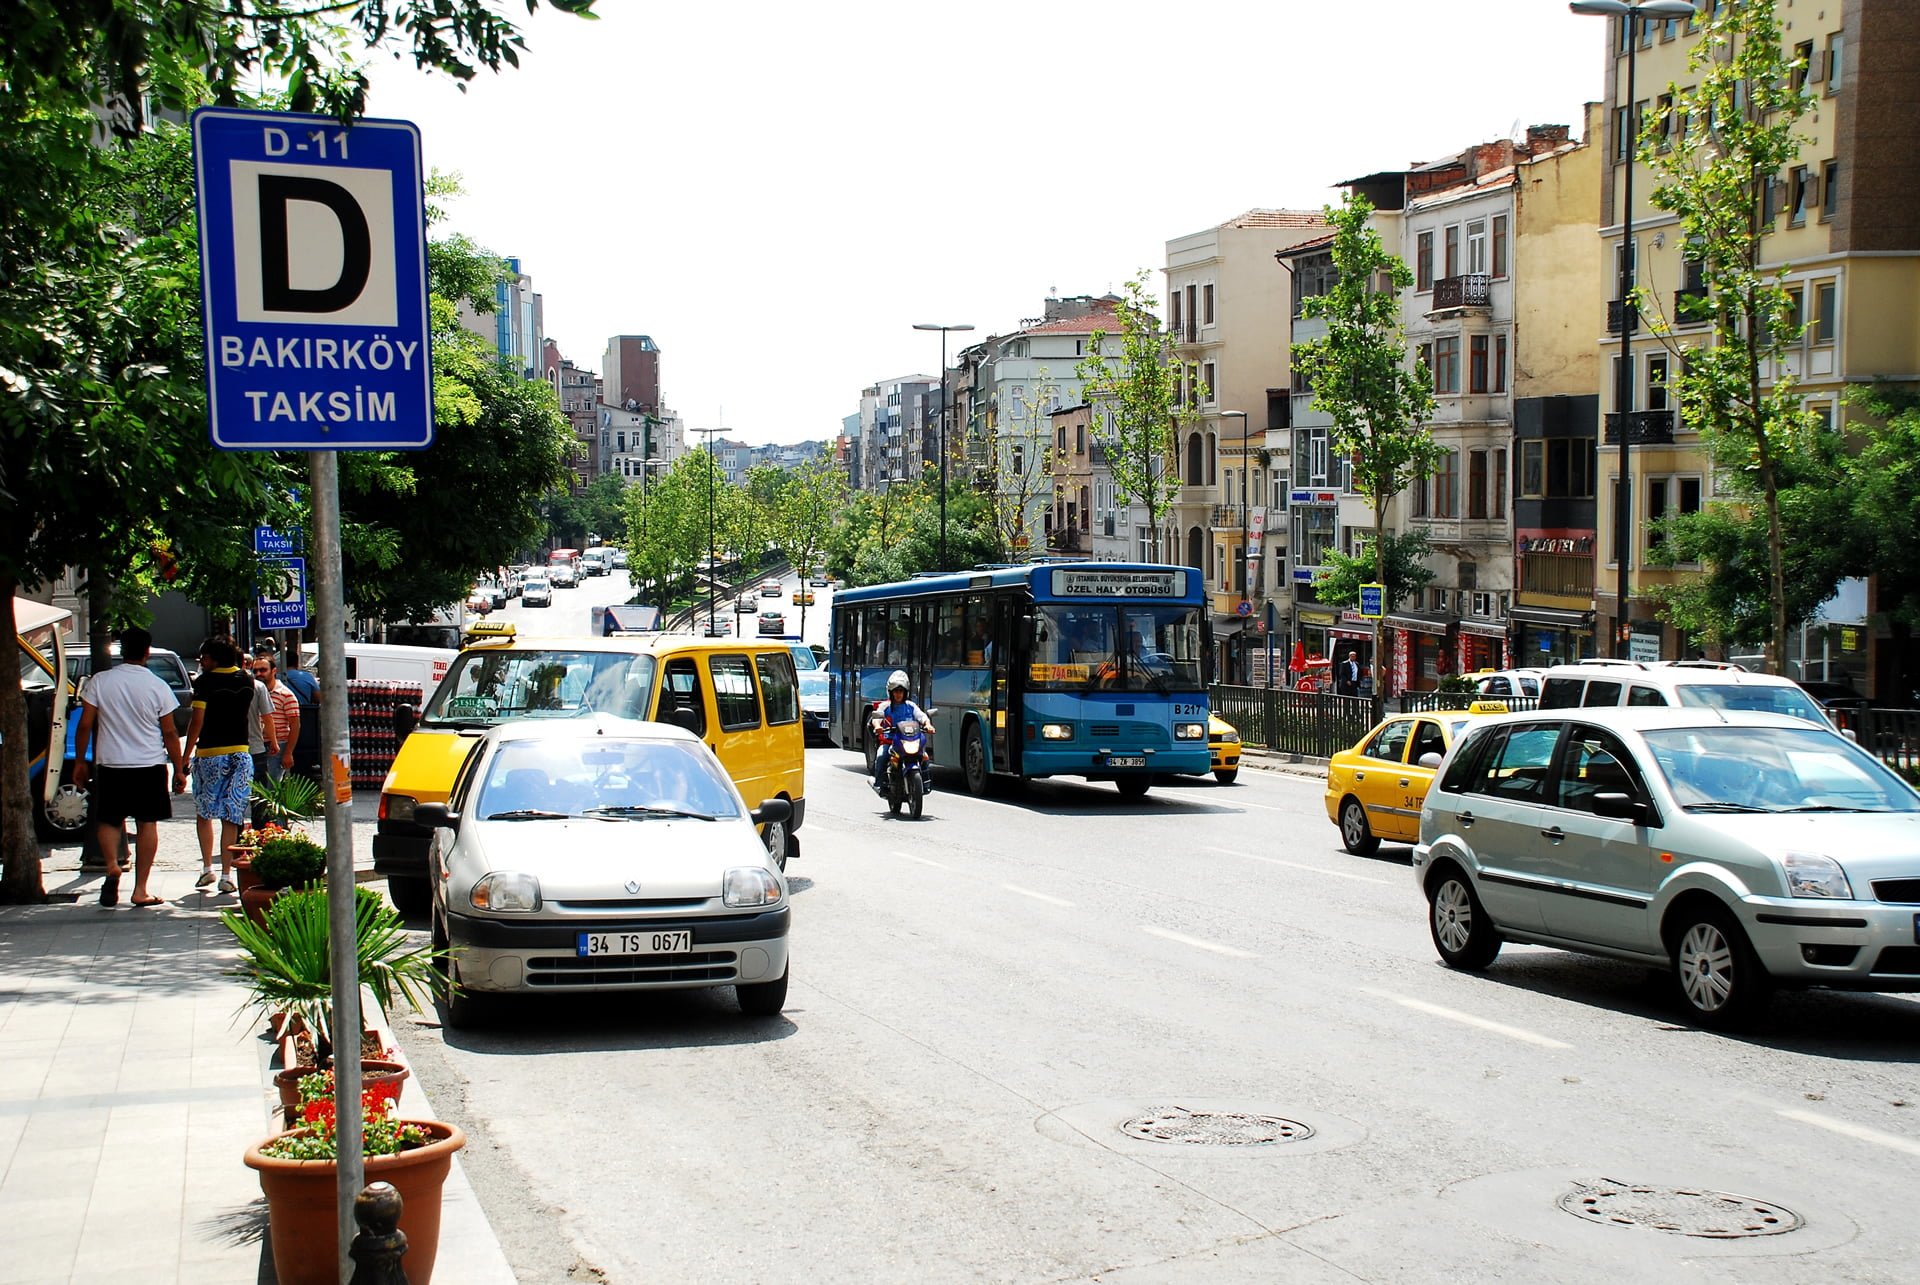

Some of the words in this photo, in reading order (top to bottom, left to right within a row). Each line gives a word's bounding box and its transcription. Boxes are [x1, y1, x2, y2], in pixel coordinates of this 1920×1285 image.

[264, 127, 349, 160] D-11
[257, 173, 371, 314] D
[220, 333, 419, 372] BAKIRKÖY
[245, 384, 397, 423] TAKSİM
[1066, 584, 1092, 593] ÖZEL
[1125, 585, 1171, 594] OTOBÜSÜ
[260, 602, 304, 614] YEŞİLKÖY
[267, 616, 300, 625] TAKSİM
[1174, 704, 1182, 715] B
[1184, 704, 1201, 715] 217
[1404, 796, 1413, 807] 34
[590, 936, 609, 953] 34
[620, 935, 640, 953] TS
[652, 932, 689, 951] 0671
